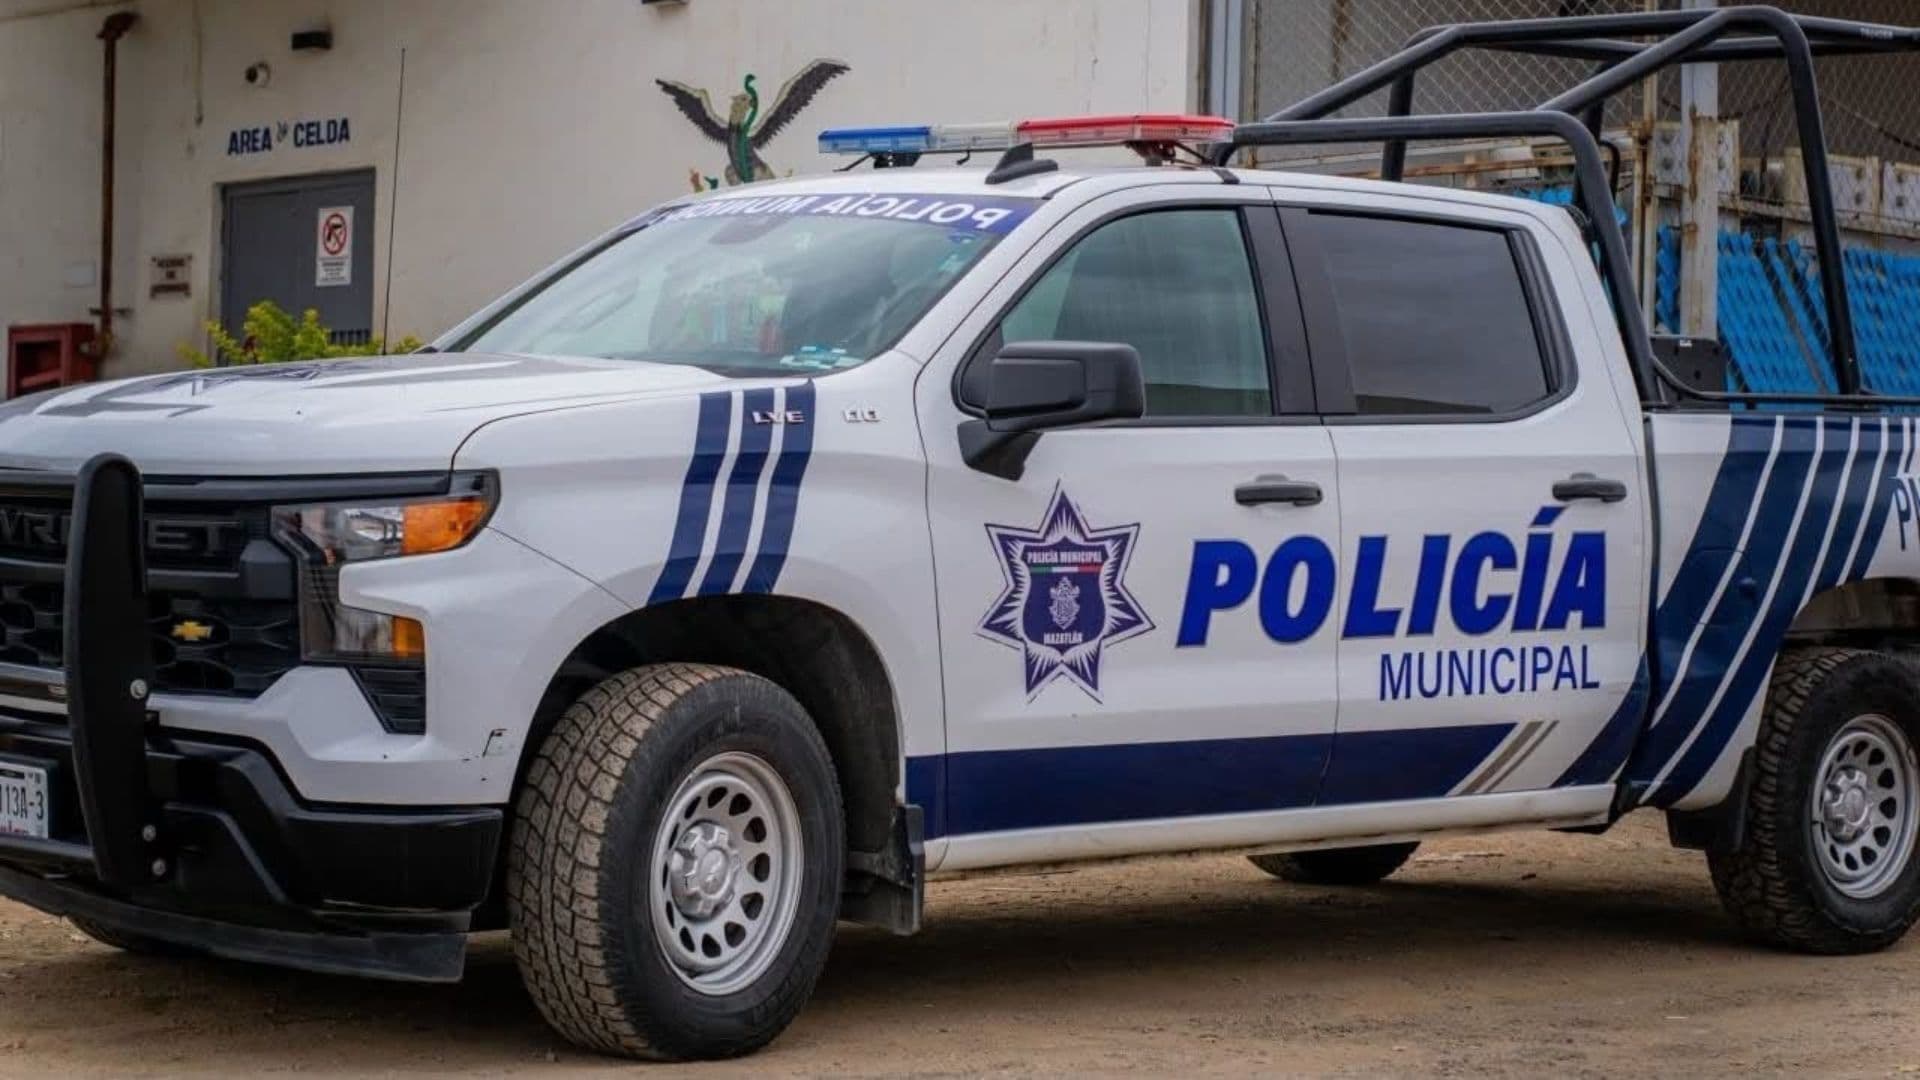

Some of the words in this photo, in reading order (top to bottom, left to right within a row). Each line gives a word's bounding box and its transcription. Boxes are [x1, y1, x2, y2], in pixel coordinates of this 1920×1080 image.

[227, 127, 272, 155] AREA
[293, 117, 350, 147] CELDA
[1026, 549, 1058, 564] POLICÍA
[1059, 551, 1102, 564] MUNICIPAL
[1176, 505, 1607, 648] POLICÍA
[1379, 644, 1601, 701] MUNICIPAL
